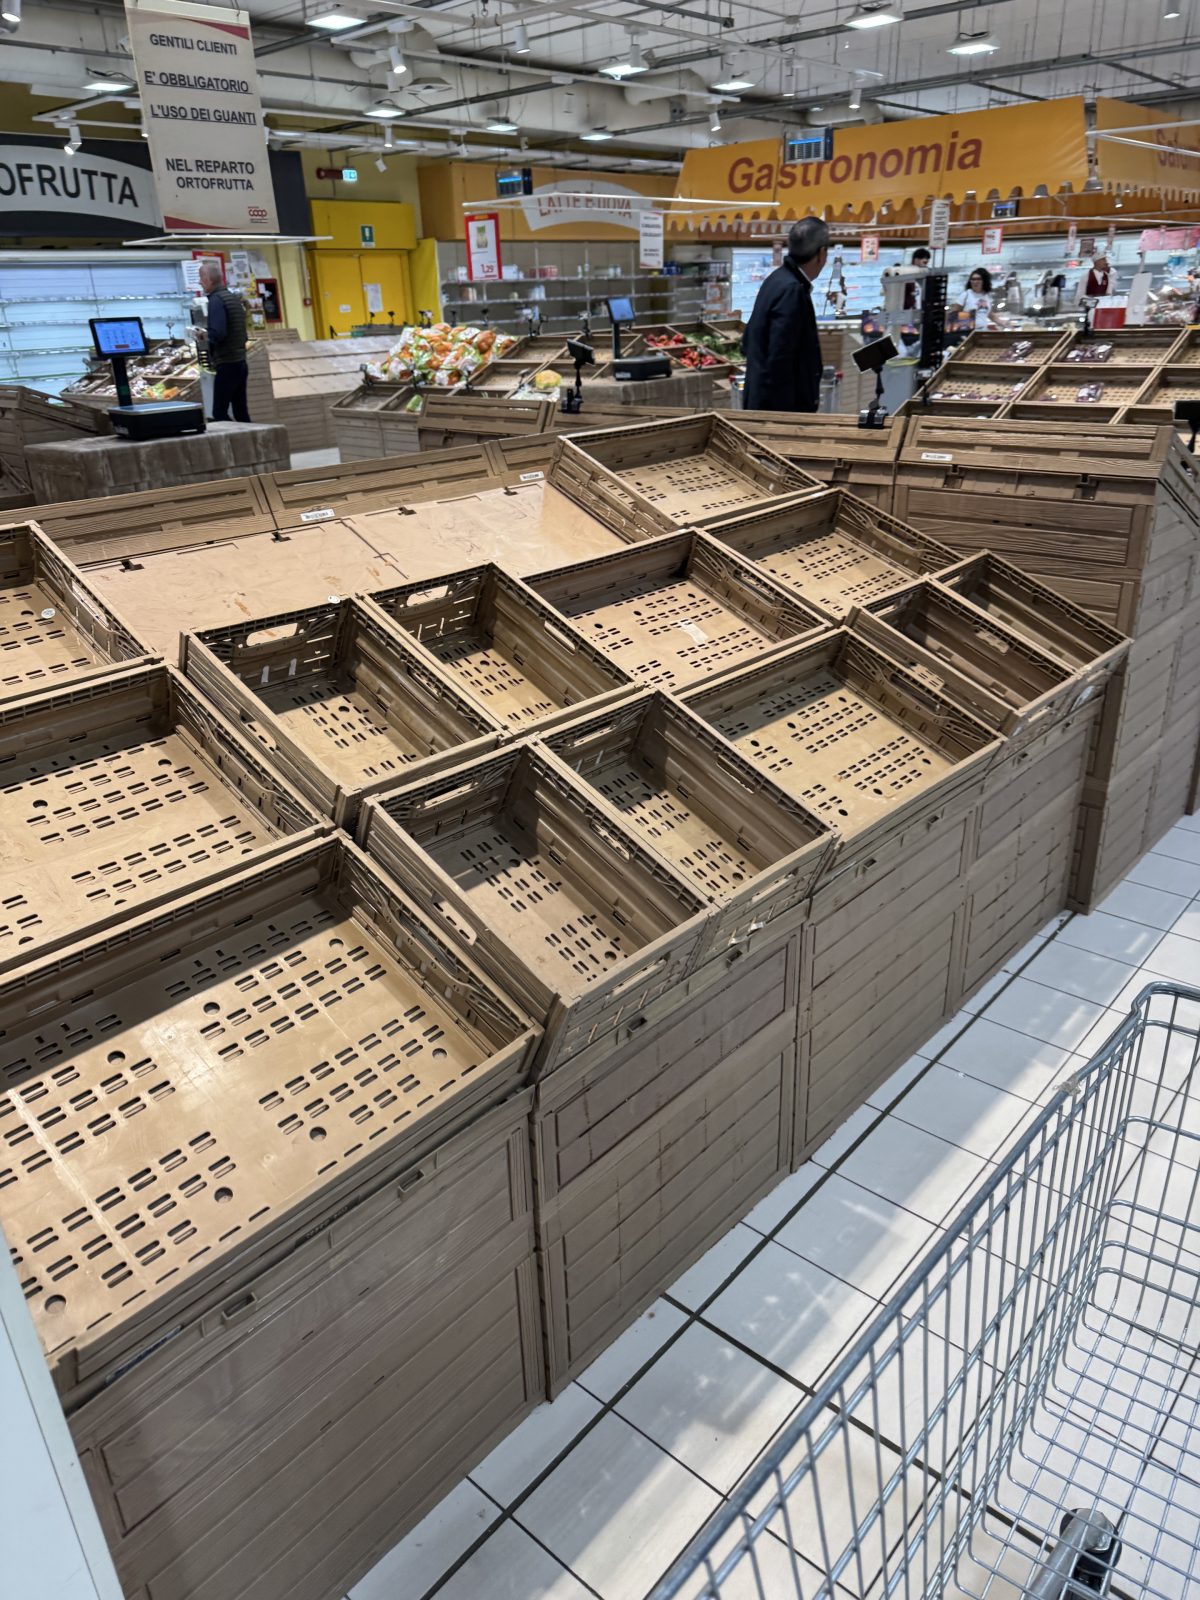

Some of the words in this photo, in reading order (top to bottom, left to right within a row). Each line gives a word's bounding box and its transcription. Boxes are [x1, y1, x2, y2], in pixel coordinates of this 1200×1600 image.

[149, 33, 194, 50] GENTILI
[196, 39, 238, 55] CLIENTI
[144, 70, 156, 84] E'
[159, 72, 249, 93] OBBLIGATORIO
[150, 104, 188, 119] L'USO
[191, 107, 211, 120] DEI
[213, 109, 256, 124] GUANTI
[165, 158, 193, 172] NEL
[195, 159, 255, 175] REPARTO
[728, 130, 983, 194] Gastronomia
[176, 176, 254, 191] ORTOFRUTTA
